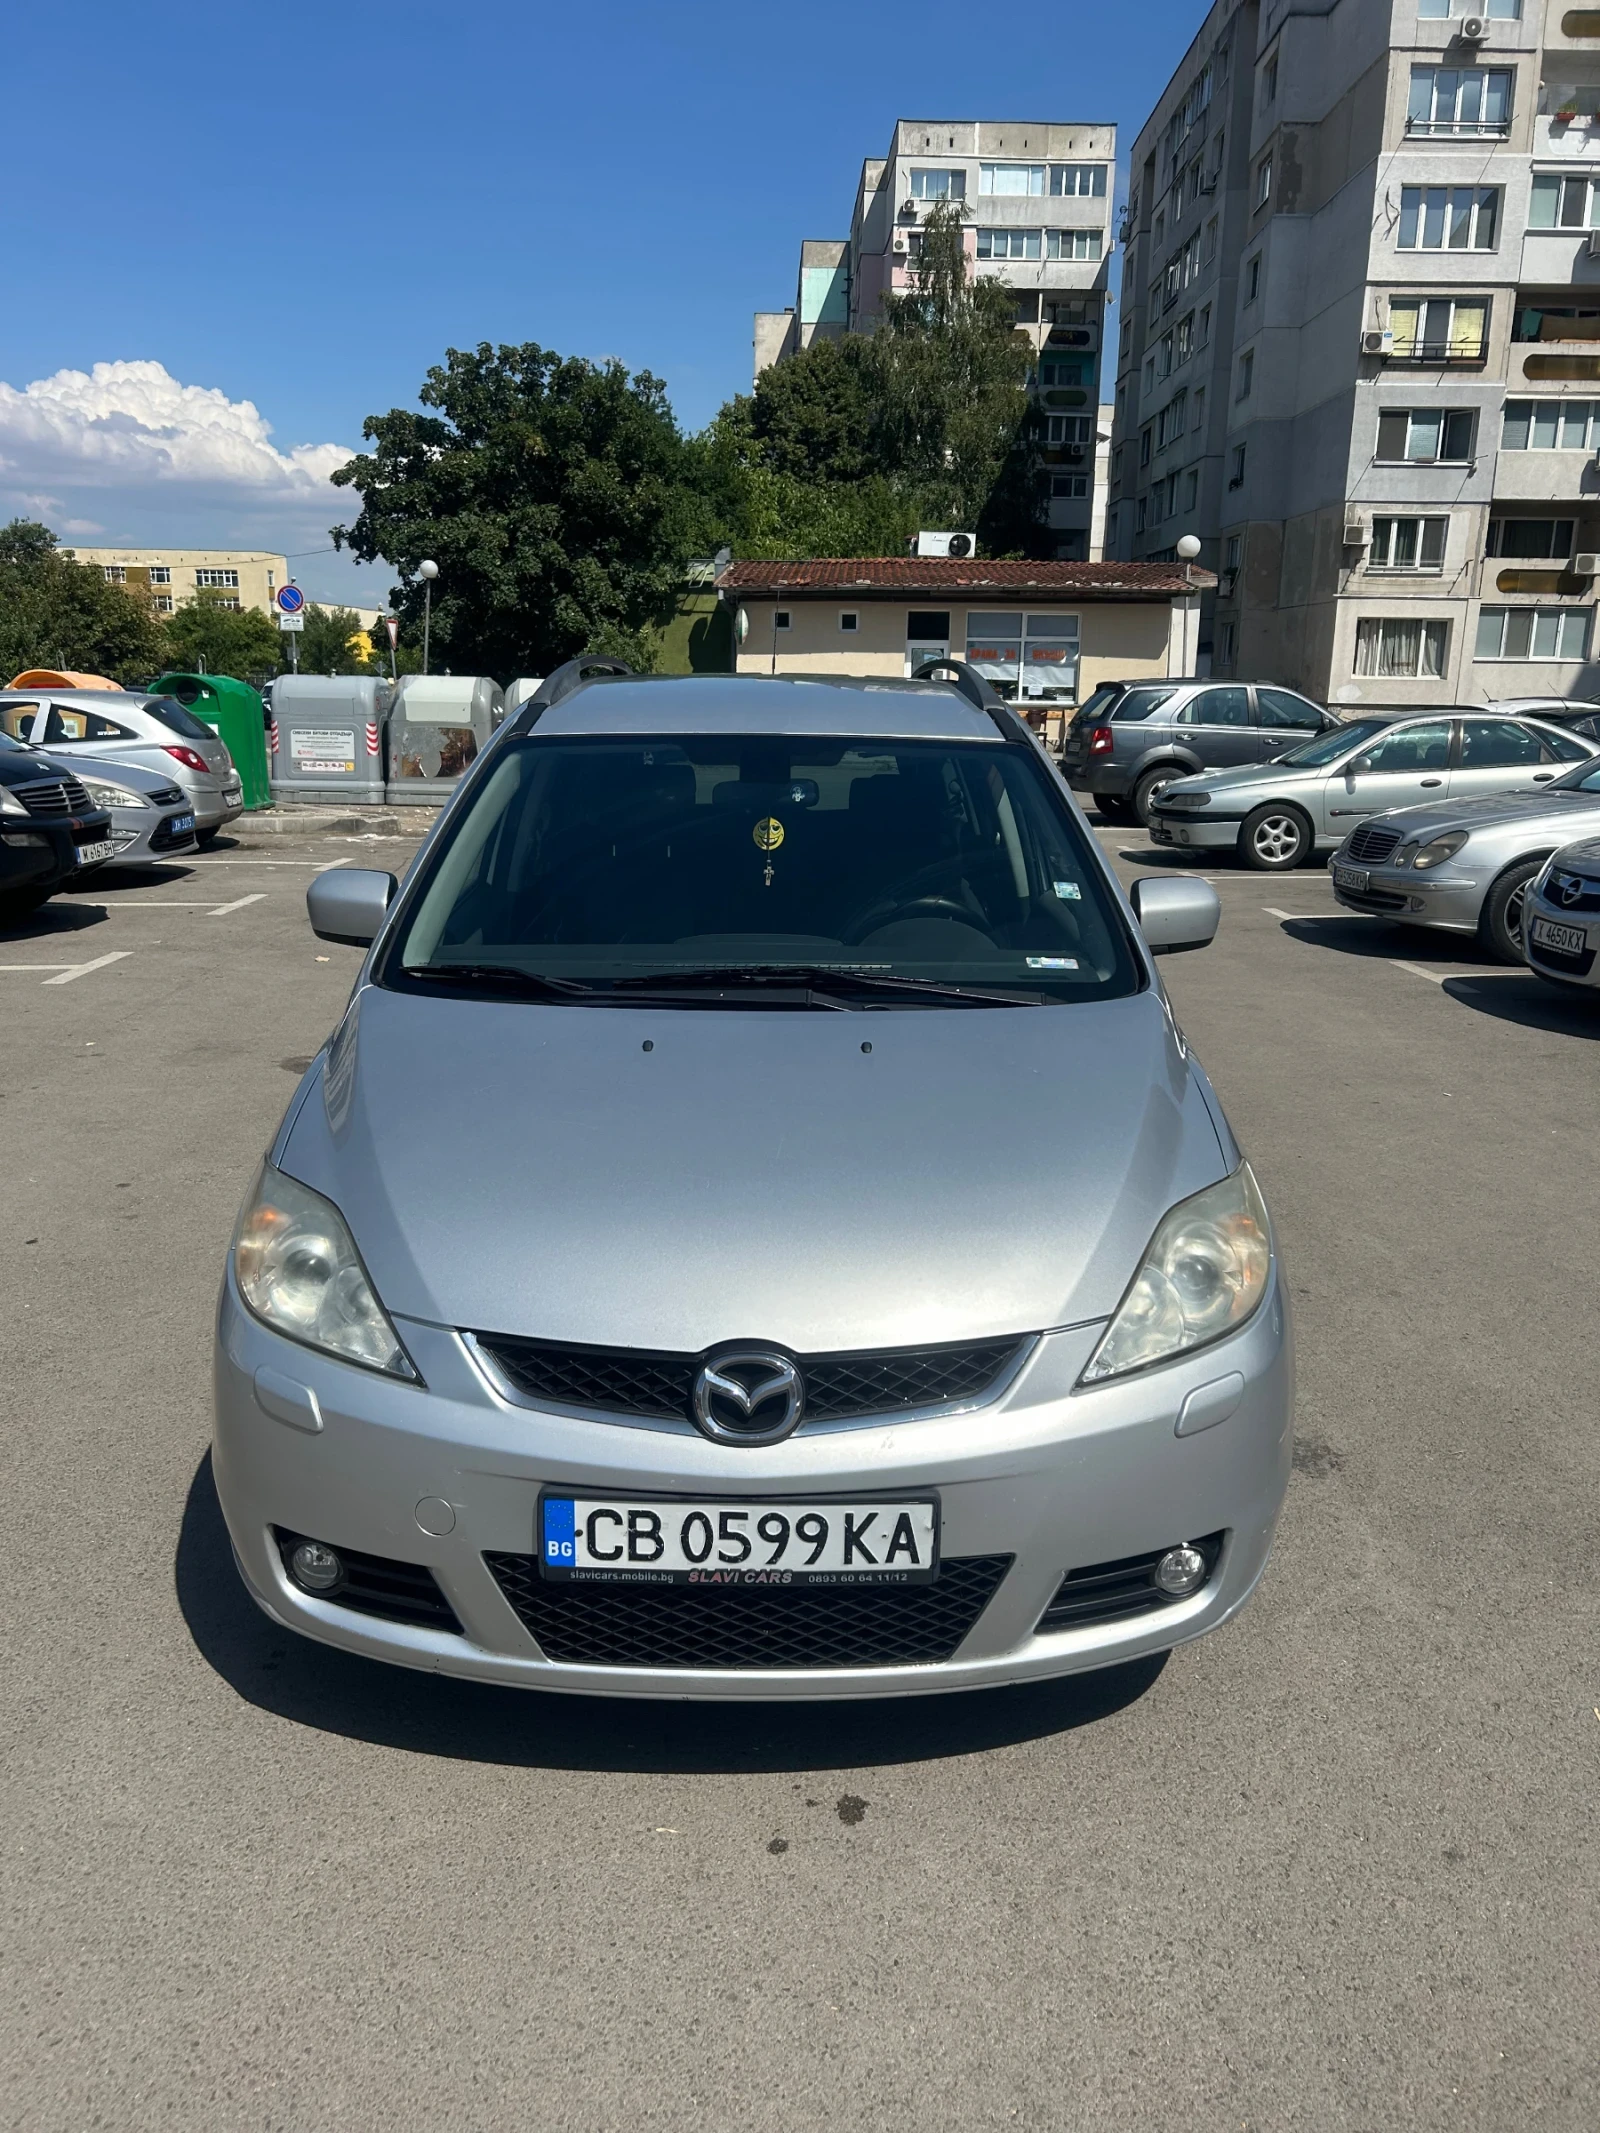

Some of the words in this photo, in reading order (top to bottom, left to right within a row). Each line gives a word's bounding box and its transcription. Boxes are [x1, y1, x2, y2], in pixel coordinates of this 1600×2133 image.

[1546, 925, 1568, 946] 4650
[1568, 930, 1582, 951] KX
[587, 1508, 664, 1562] CB
[681, 1511, 829, 1565] 0599
[844, 1512, 920, 1565] KA
[548, 1541, 573, 1557] BG
[570, 1571, 674, 1583] slavicars.mobile.bg
[688, 1570, 739, 1583] SLAVI
[744, 1570, 793, 1584] CARS
[808, 1574, 837, 1583] 0893
[840, 1574, 855, 1582] 60
[877, 1573, 908, 1581] 11/12
